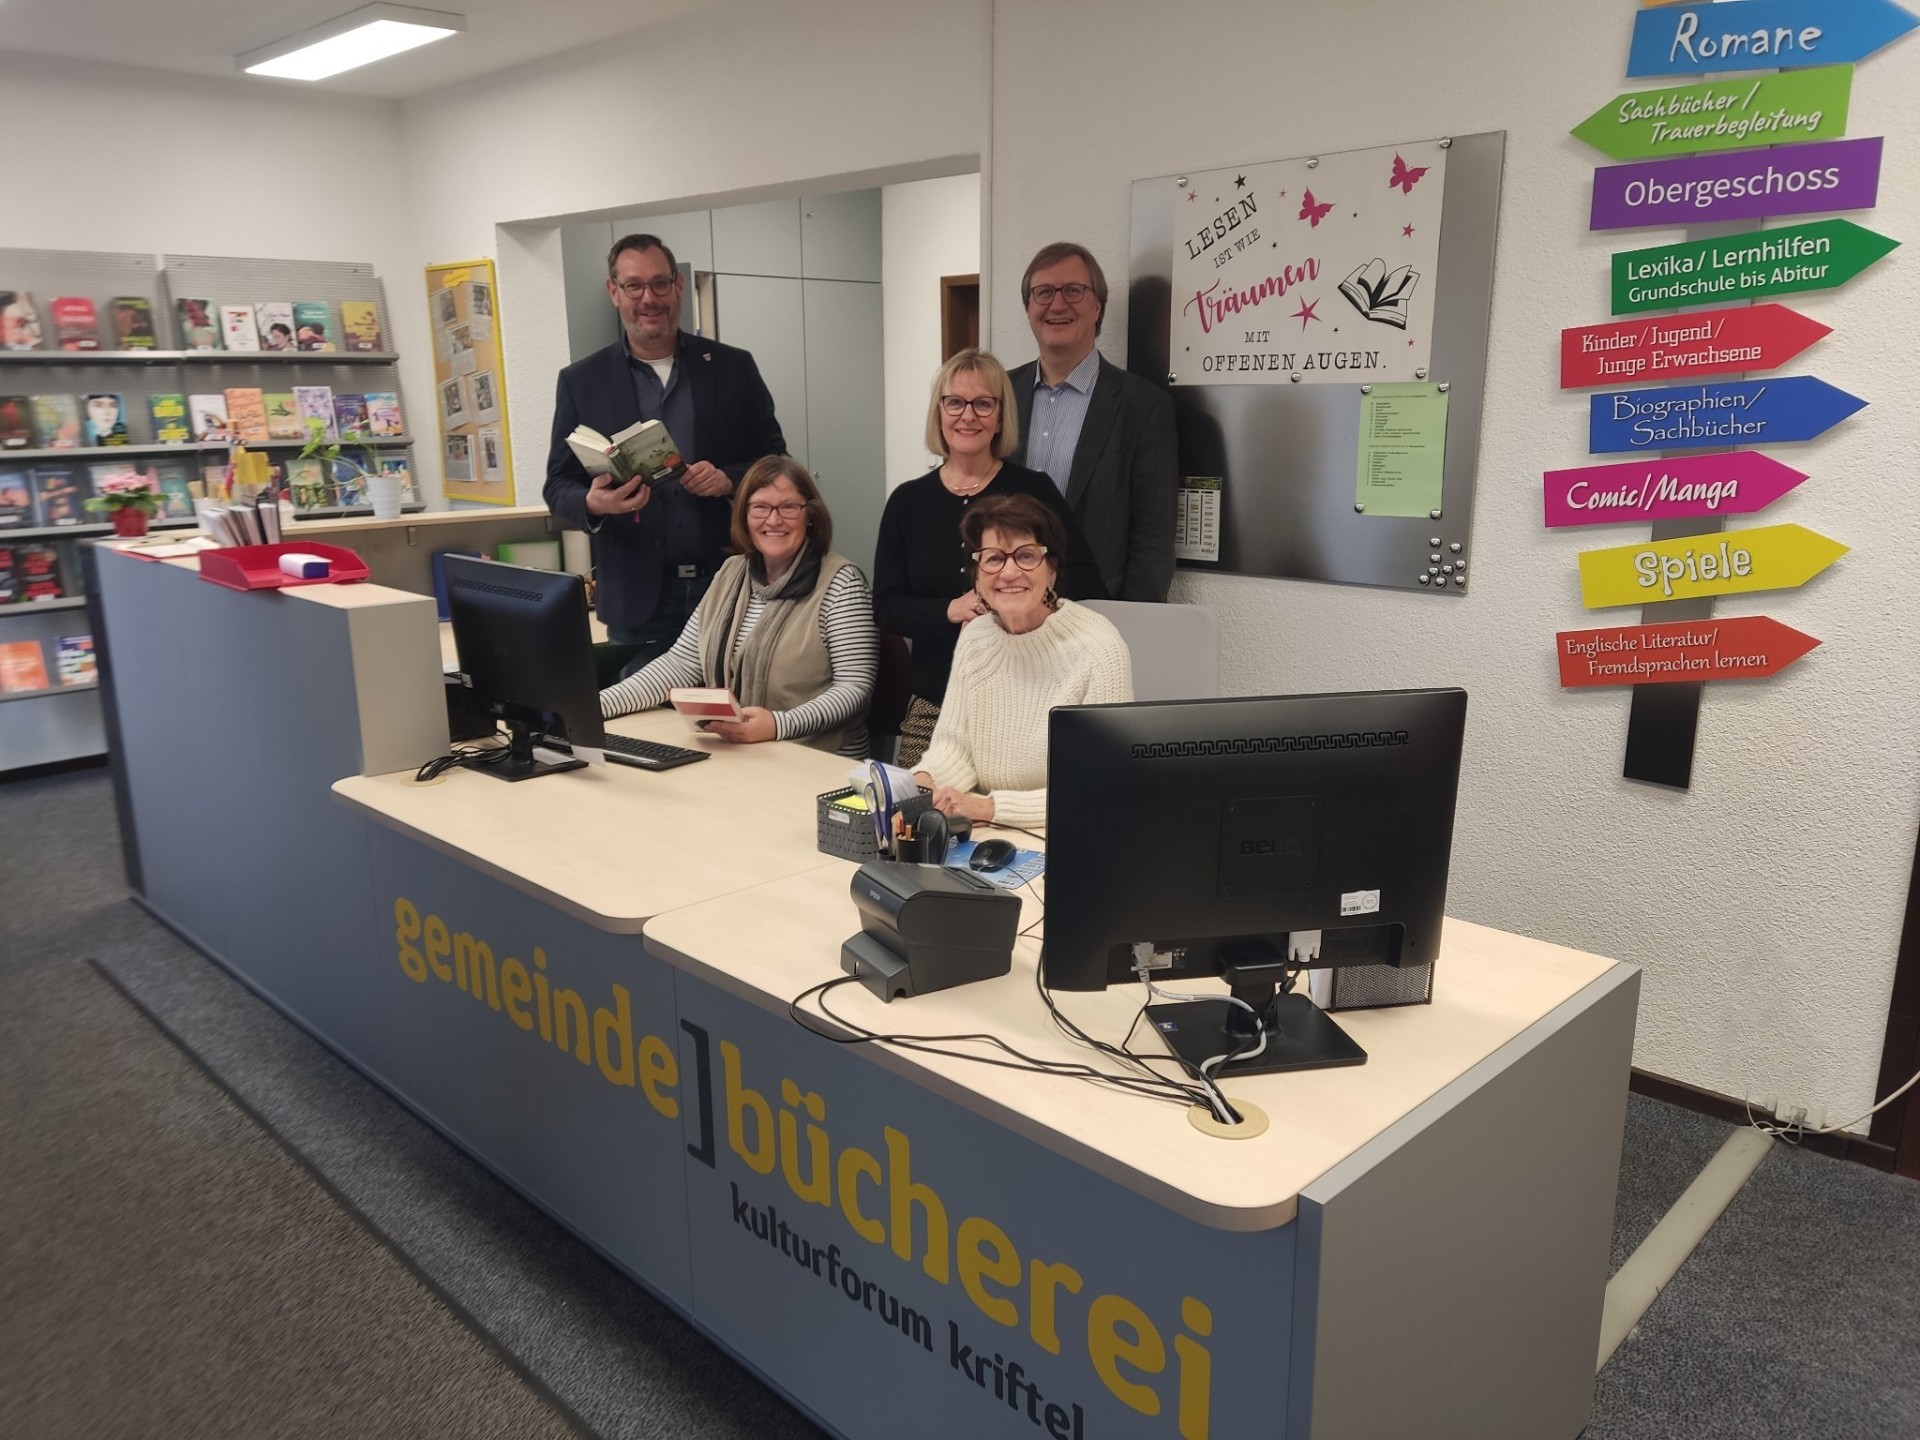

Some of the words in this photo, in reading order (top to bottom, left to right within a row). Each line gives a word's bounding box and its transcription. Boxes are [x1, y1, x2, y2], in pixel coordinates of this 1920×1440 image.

[1668, 11, 1823, 63] Romane
[1617, 93, 1738, 125] Sachbücher
[1649, 108, 1823, 145] Trauerbegleitung
[1624, 166, 1840, 208] Obergeschoss
[1184, 191, 1259, 260] LESEN
[1212, 247, 1234, 269] IST
[1234, 228, 1262, 253] WIE
[1712, 234, 1831, 270] Lernhilfen
[1183, 257, 1321, 334] träumen
[1628, 273, 1736, 304] Grundschule
[1741, 271, 1766, 288] bis
[1770, 263, 1830, 285] Abitur
[1244, 331, 1271, 344] MIT
[1202, 353, 1296, 372] OFFENEN
[1302, 351, 1388, 370] AUGEN.
[1597, 355, 1646, 376] Junge
[1651, 344, 1762, 370] Erwachsene
[1612, 386, 1767, 421] Biographien/
[1629, 413, 1767, 446] Sachbücher
[1566, 472, 1738, 511] Comic/Manga
[1633, 541, 1752, 597] Spiele
[1566, 636, 1638, 657] Englische
[1640, 628, 1719, 649] Literatur/
[1588, 651, 1711, 677] Fremdsprachen
[1715, 650, 1769, 669] lernen
[394, 896, 680, 1120] gemeinde
[720, 1039, 1214, 1440] bücherei
[730, 1181, 934, 1352] kulturforum
[948, 1320, 1085, 1440] kriftel
